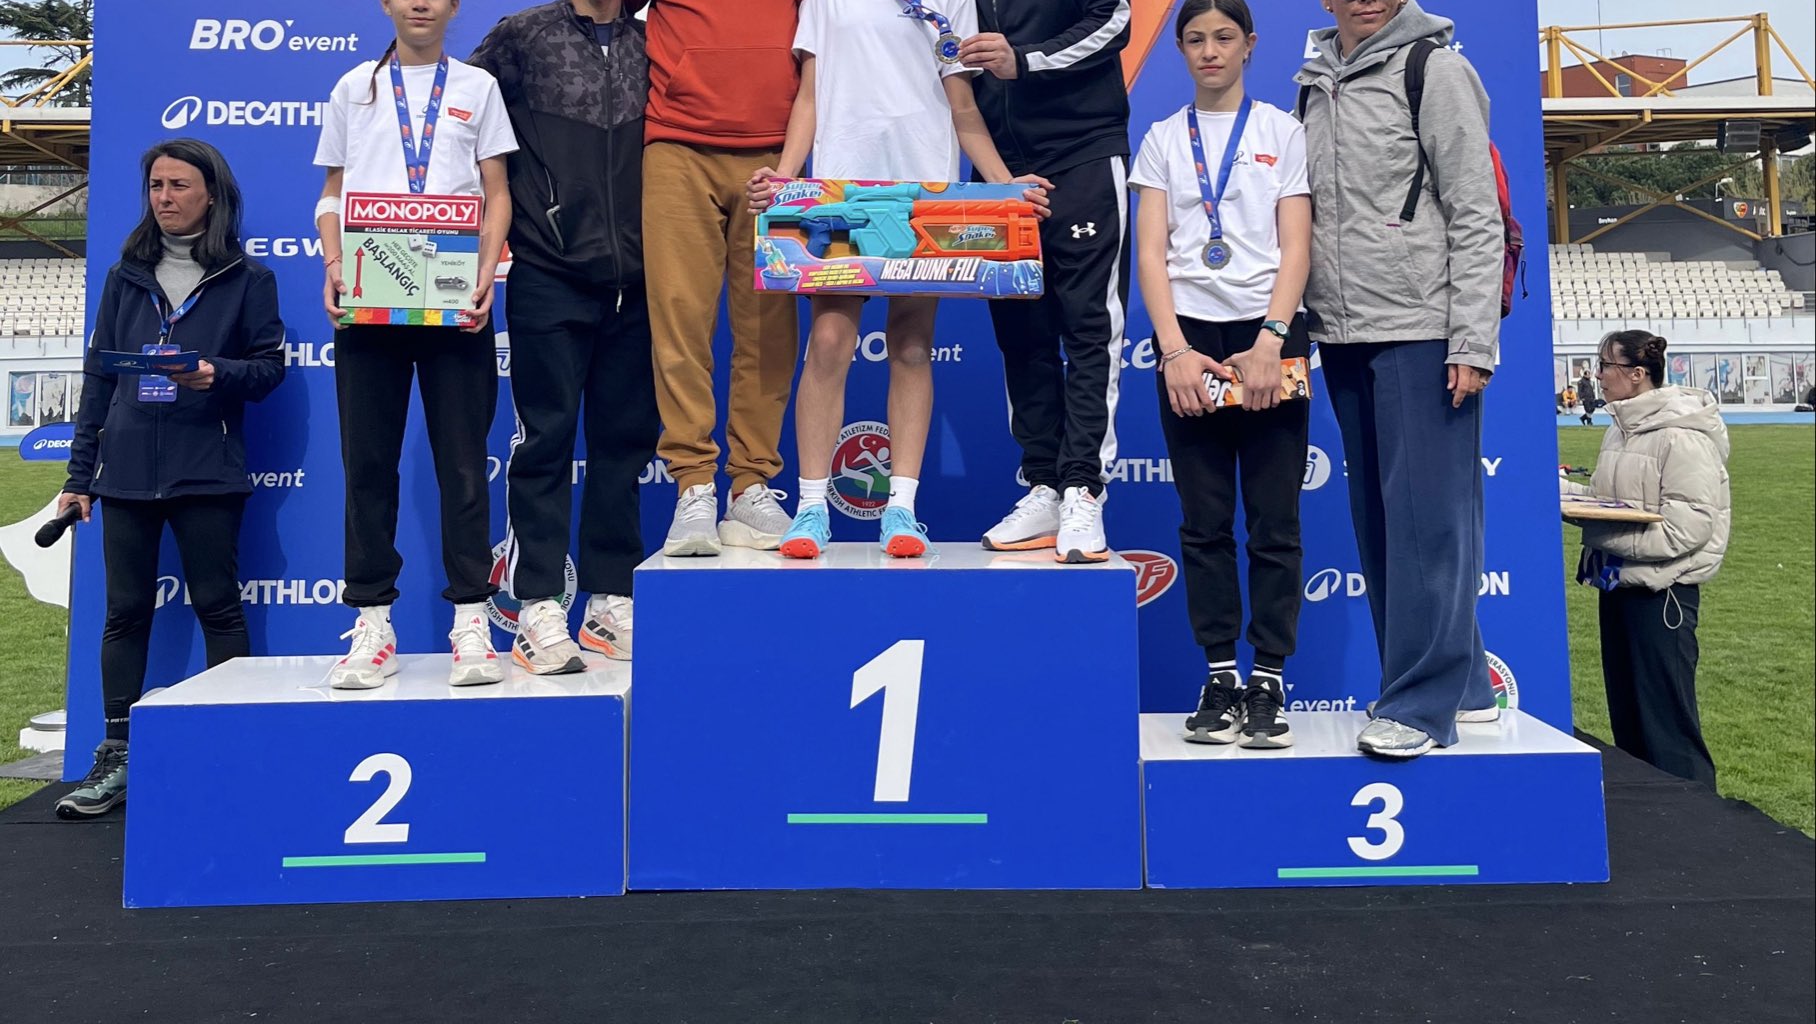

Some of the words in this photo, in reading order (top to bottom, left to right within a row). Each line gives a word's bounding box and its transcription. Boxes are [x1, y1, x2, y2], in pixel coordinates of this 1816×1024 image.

[189, 19, 285, 51] BRO
[288, 32, 359, 51] event
[353, 201, 474, 221] MONOPOLY
[245, 238, 325, 257] EGW
[362, 237, 420, 296] BAŞLANGIÇ
[880, 259, 915, 280] MEGA
[912, 258, 953, 281] DUNK
[950, 257, 982, 281] FILL
[47, 439, 73, 448] DECA
[248, 469, 305, 487] vent
[827, 480, 844, 507] URKISH
[849, 639, 925, 802] 1
[343, 752, 413, 844] 2
[1346, 782, 1405, 861] 3
